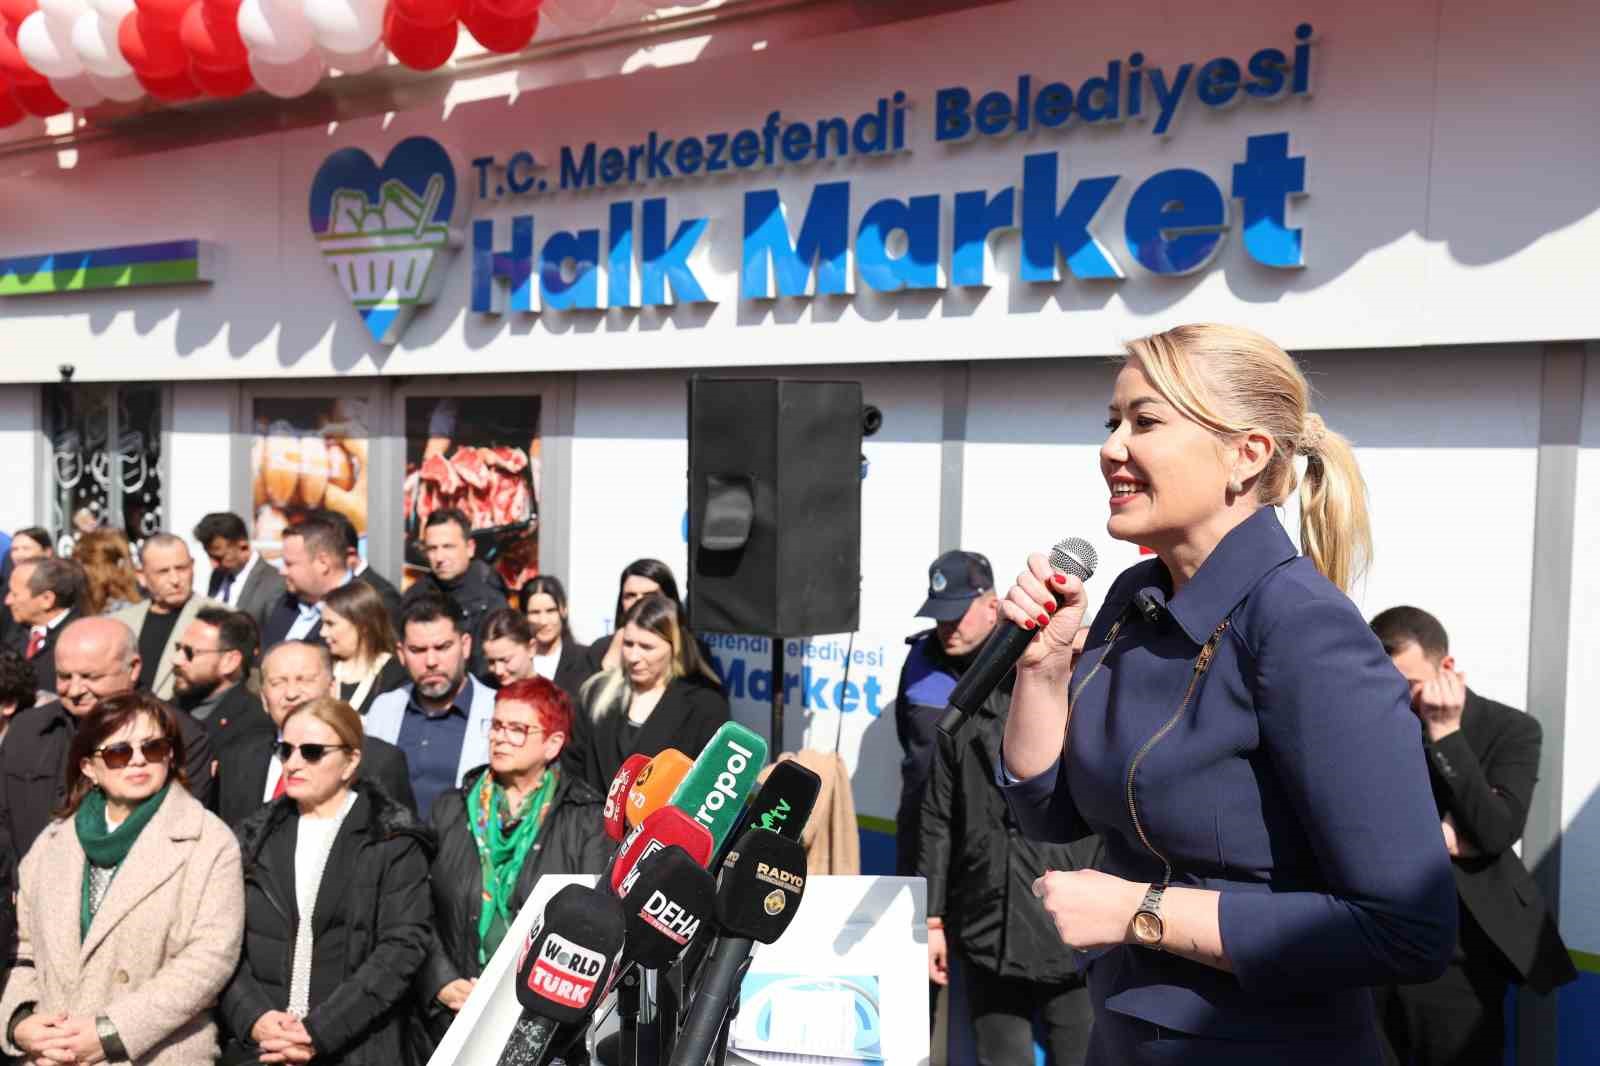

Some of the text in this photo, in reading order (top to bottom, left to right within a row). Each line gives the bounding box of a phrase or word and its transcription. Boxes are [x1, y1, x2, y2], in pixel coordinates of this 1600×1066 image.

[471, 23, 1314, 199] T.C. Merkezefendi Belediyesi
[470, 132, 1307, 313] Halk Market
[786, 640, 884, 670] elediyesi
[757, 862, 804, 888] RADYO
[642, 889, 701, 941] DEHA
[545, 940, 601, 977] WORLD
[533, 966, 590, 1004] TÜRK
